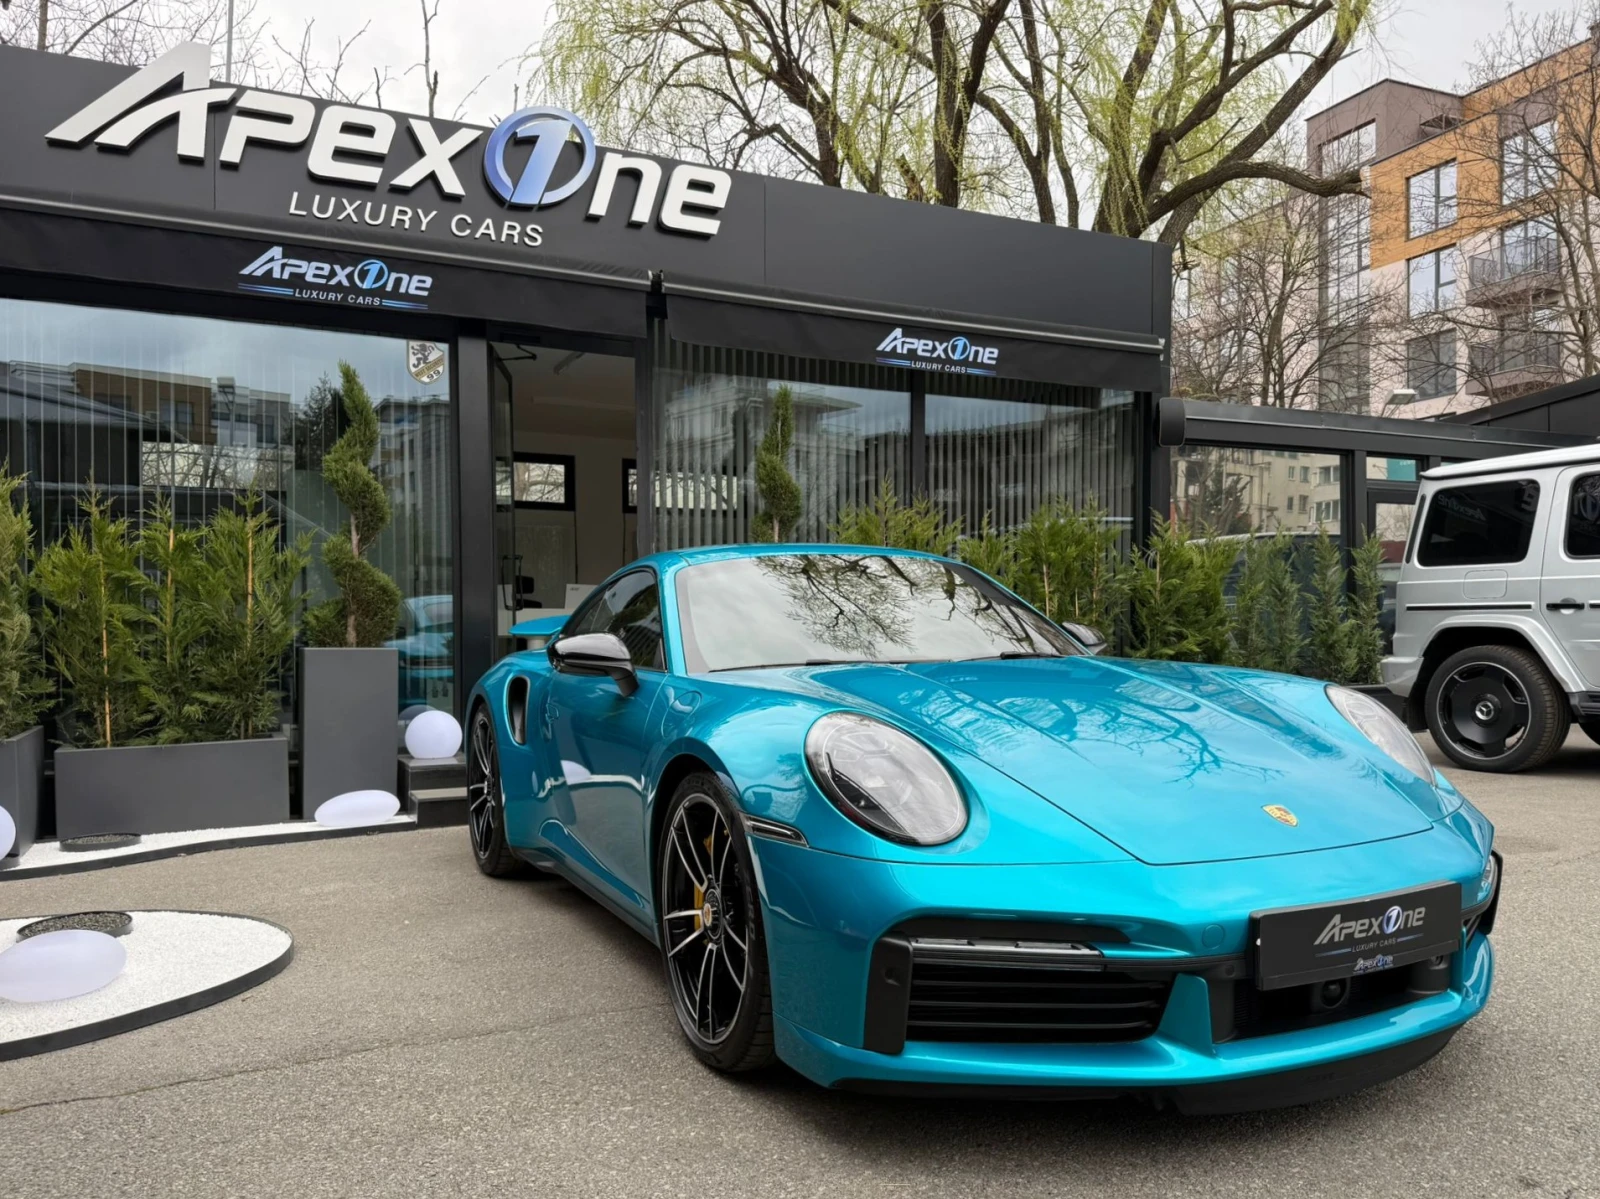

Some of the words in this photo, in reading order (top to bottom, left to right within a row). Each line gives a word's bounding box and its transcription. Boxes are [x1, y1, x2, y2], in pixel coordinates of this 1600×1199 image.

[289, 190, 437, 232] LUXURY
[450, 213, 544, 247] CARS
[294, 288, 343, 302] LUXURY
[347, 294, 381, 306] CARS
[426, 369, 441, 380] 99
[911, 360, 942, 371] LUXURY
[944, 364, 967, 374] CARS
[1352, 941, 1378, 953] LUXURY
[1379, 937, 1397, 947] CARS
